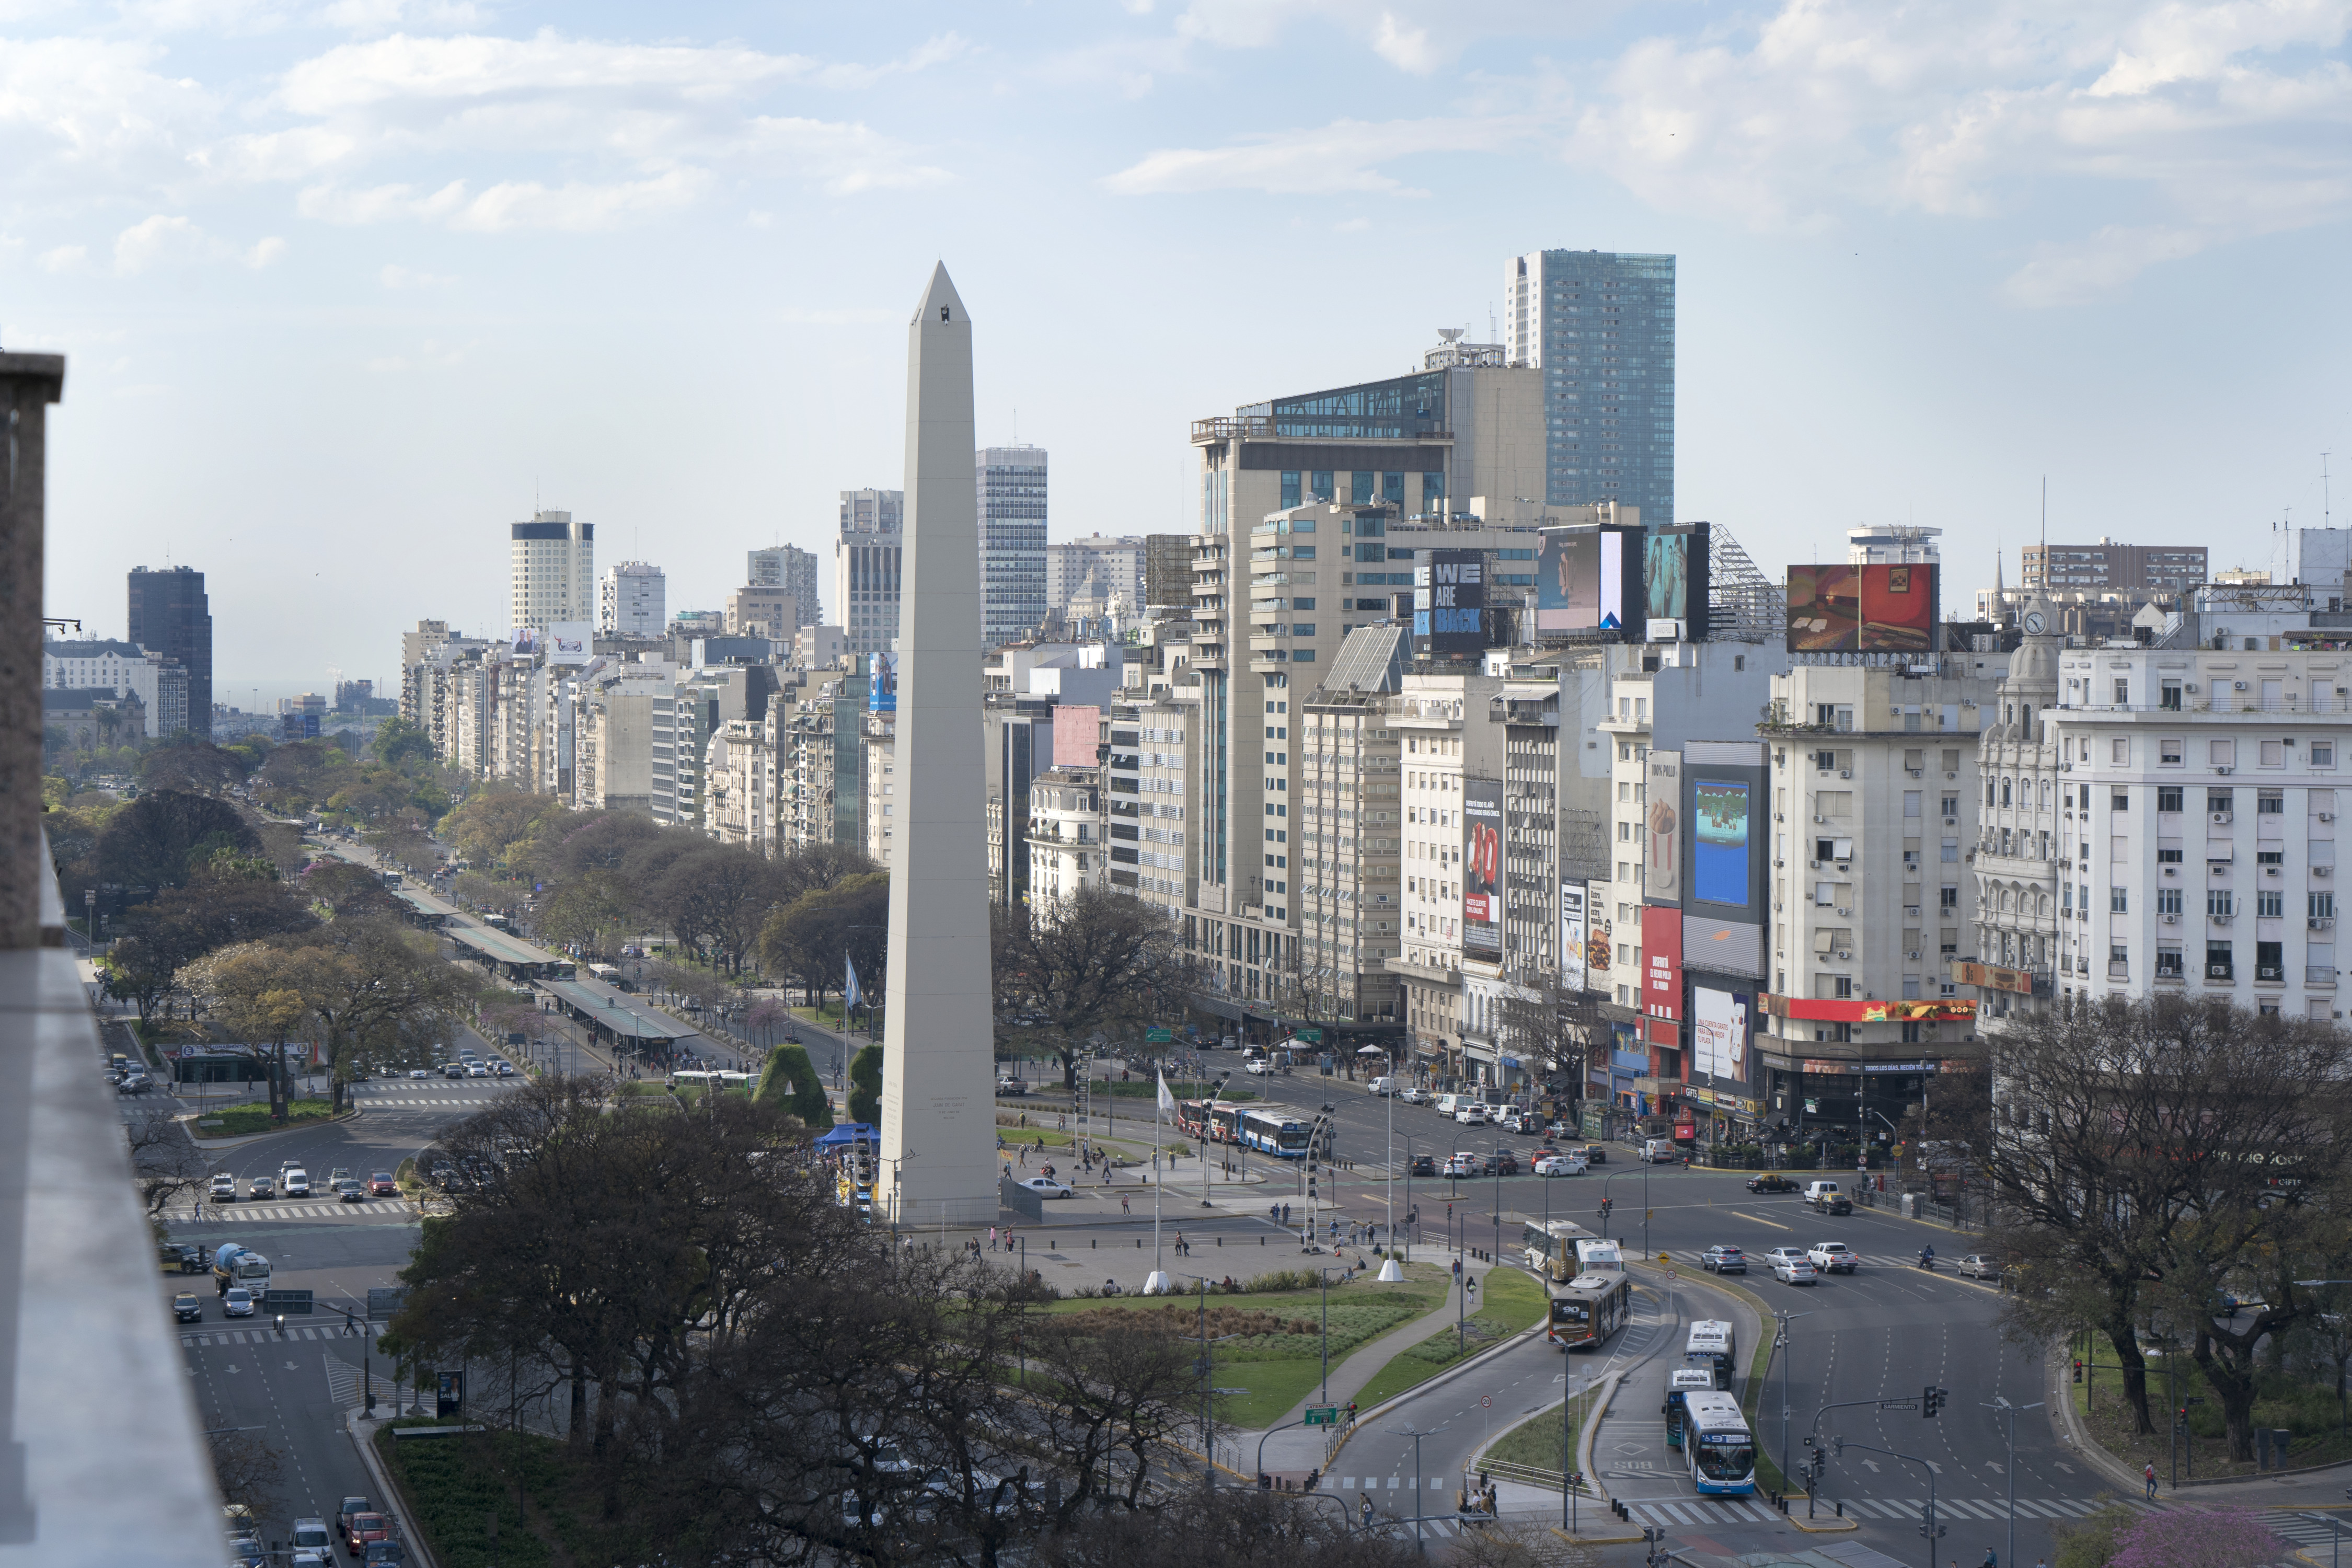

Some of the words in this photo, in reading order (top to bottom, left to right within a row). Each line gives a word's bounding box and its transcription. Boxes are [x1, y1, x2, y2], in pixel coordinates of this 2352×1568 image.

[1436, 564, 1480, 583] WE
[1436, 586, 1456, 606] ARE
[1435, 608, 1481, 632] BACK
[1652, 764, 1662, 776] 100%
[1663, 765, 1675, 777] POLLO
[1591, 900, 1605, 909] tamaño,
[1653, 955, 1668, 969] DISFRUTÁ
[1650, 969, 1653, 977] EL
[1653, 969, 1662, 978] MEJOR
[1663, 970, 1671, 980] POLLO
[1658, 981, 1668, 990] MUNDO
[1704, 1020, 1717, 1029] CUENTA
[1714, 1031, 1725, 1039] MEJOR
